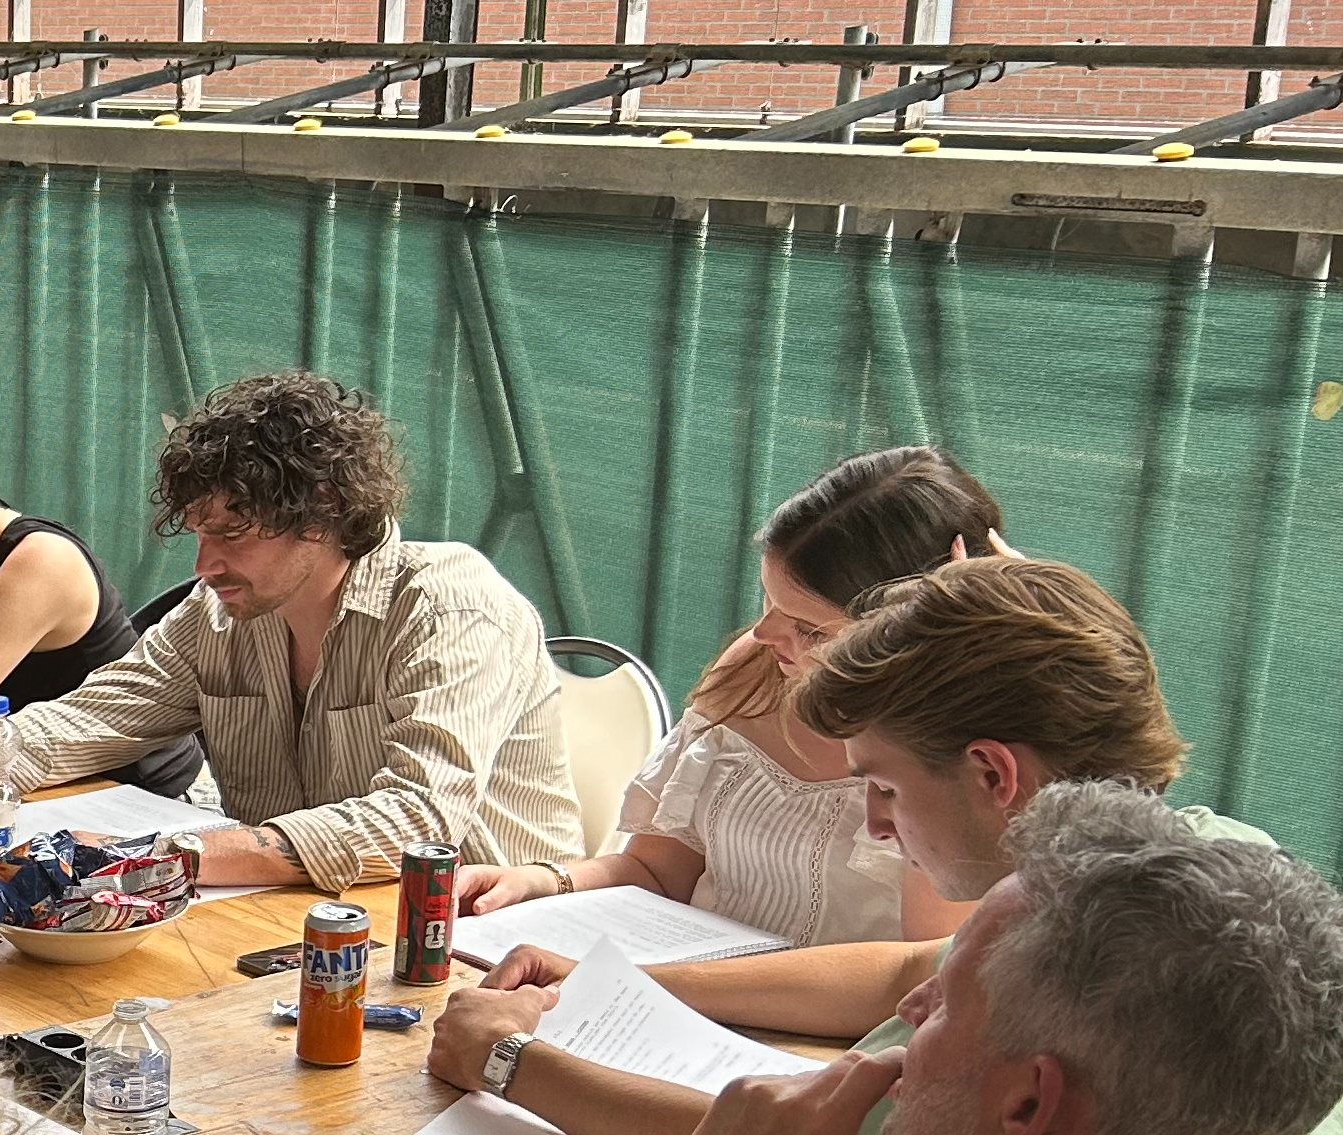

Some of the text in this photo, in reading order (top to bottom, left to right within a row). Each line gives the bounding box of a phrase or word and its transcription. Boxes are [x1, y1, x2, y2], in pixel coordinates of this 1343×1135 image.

[302, 939, 369, 976] FANT
[309, 969, 363, 984] zero sugar
